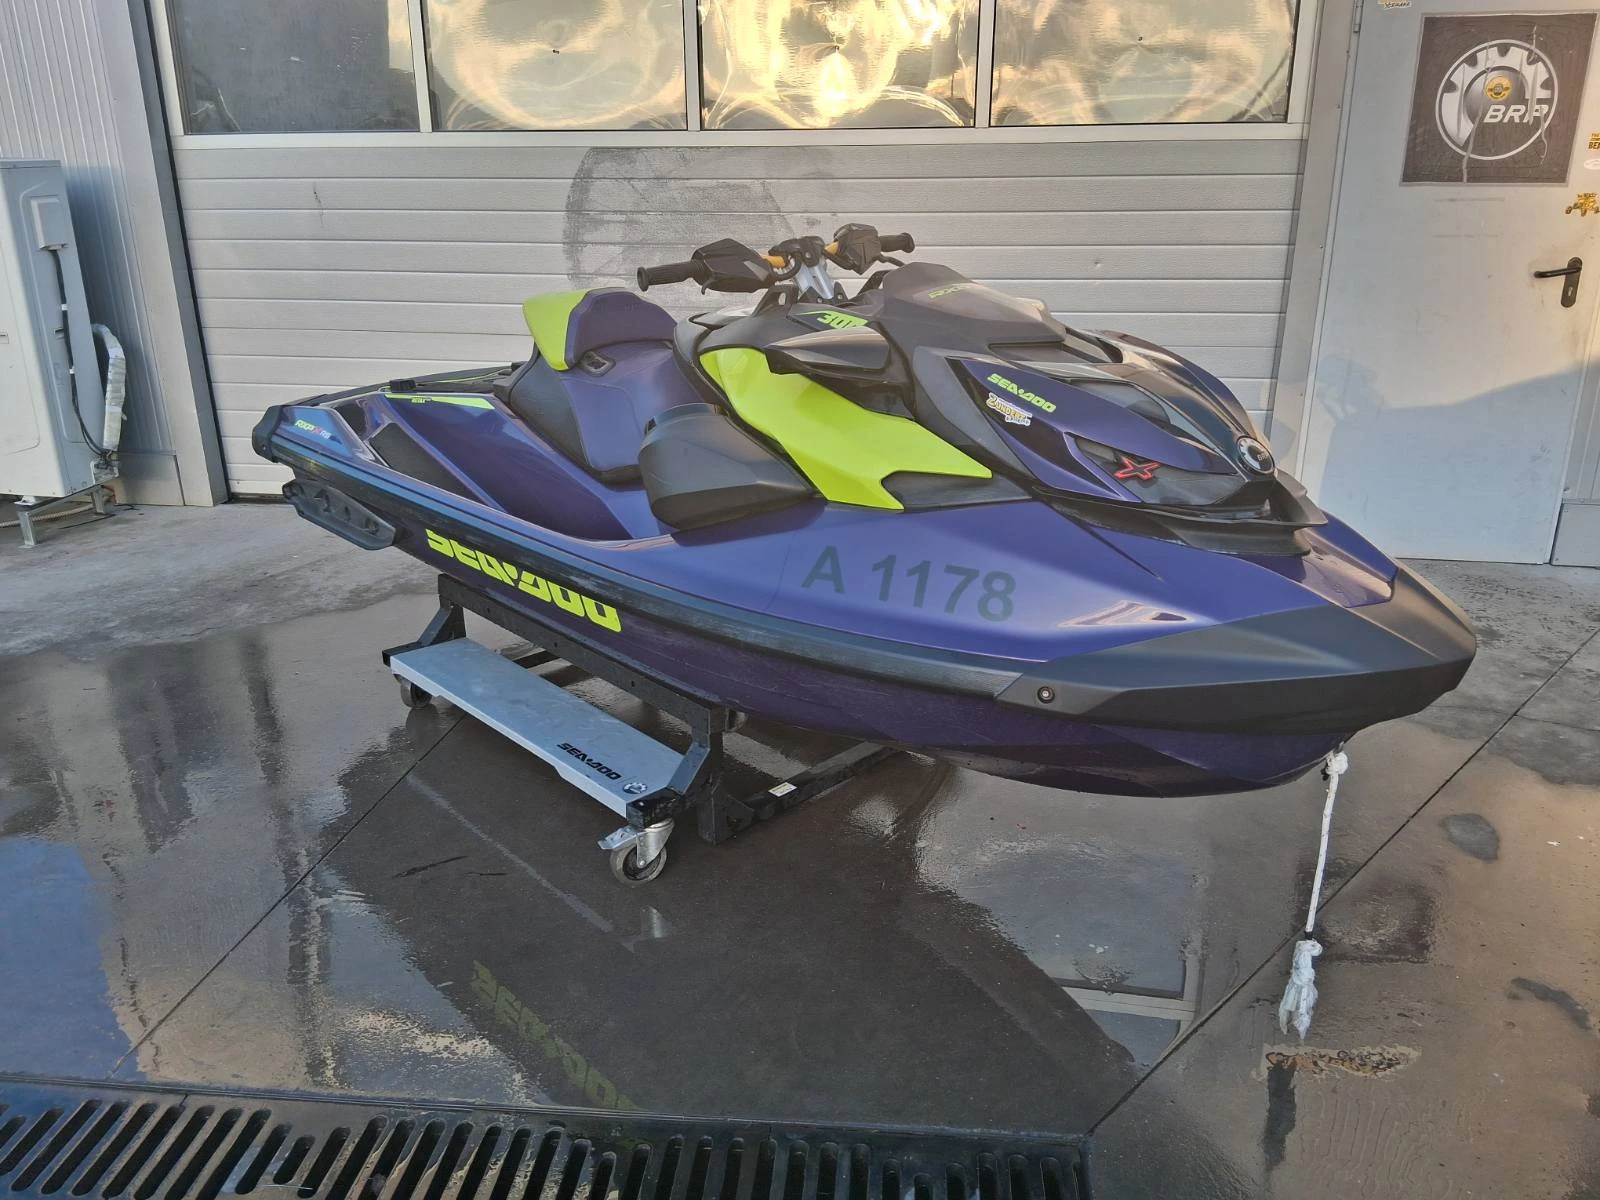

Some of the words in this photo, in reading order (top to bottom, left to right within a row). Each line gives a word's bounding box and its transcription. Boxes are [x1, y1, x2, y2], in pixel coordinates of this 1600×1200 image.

[1484, 104, 1548, 123] BRP
[801, 545, 845, 594] A
[872, 555, 1017, 622] 1178
